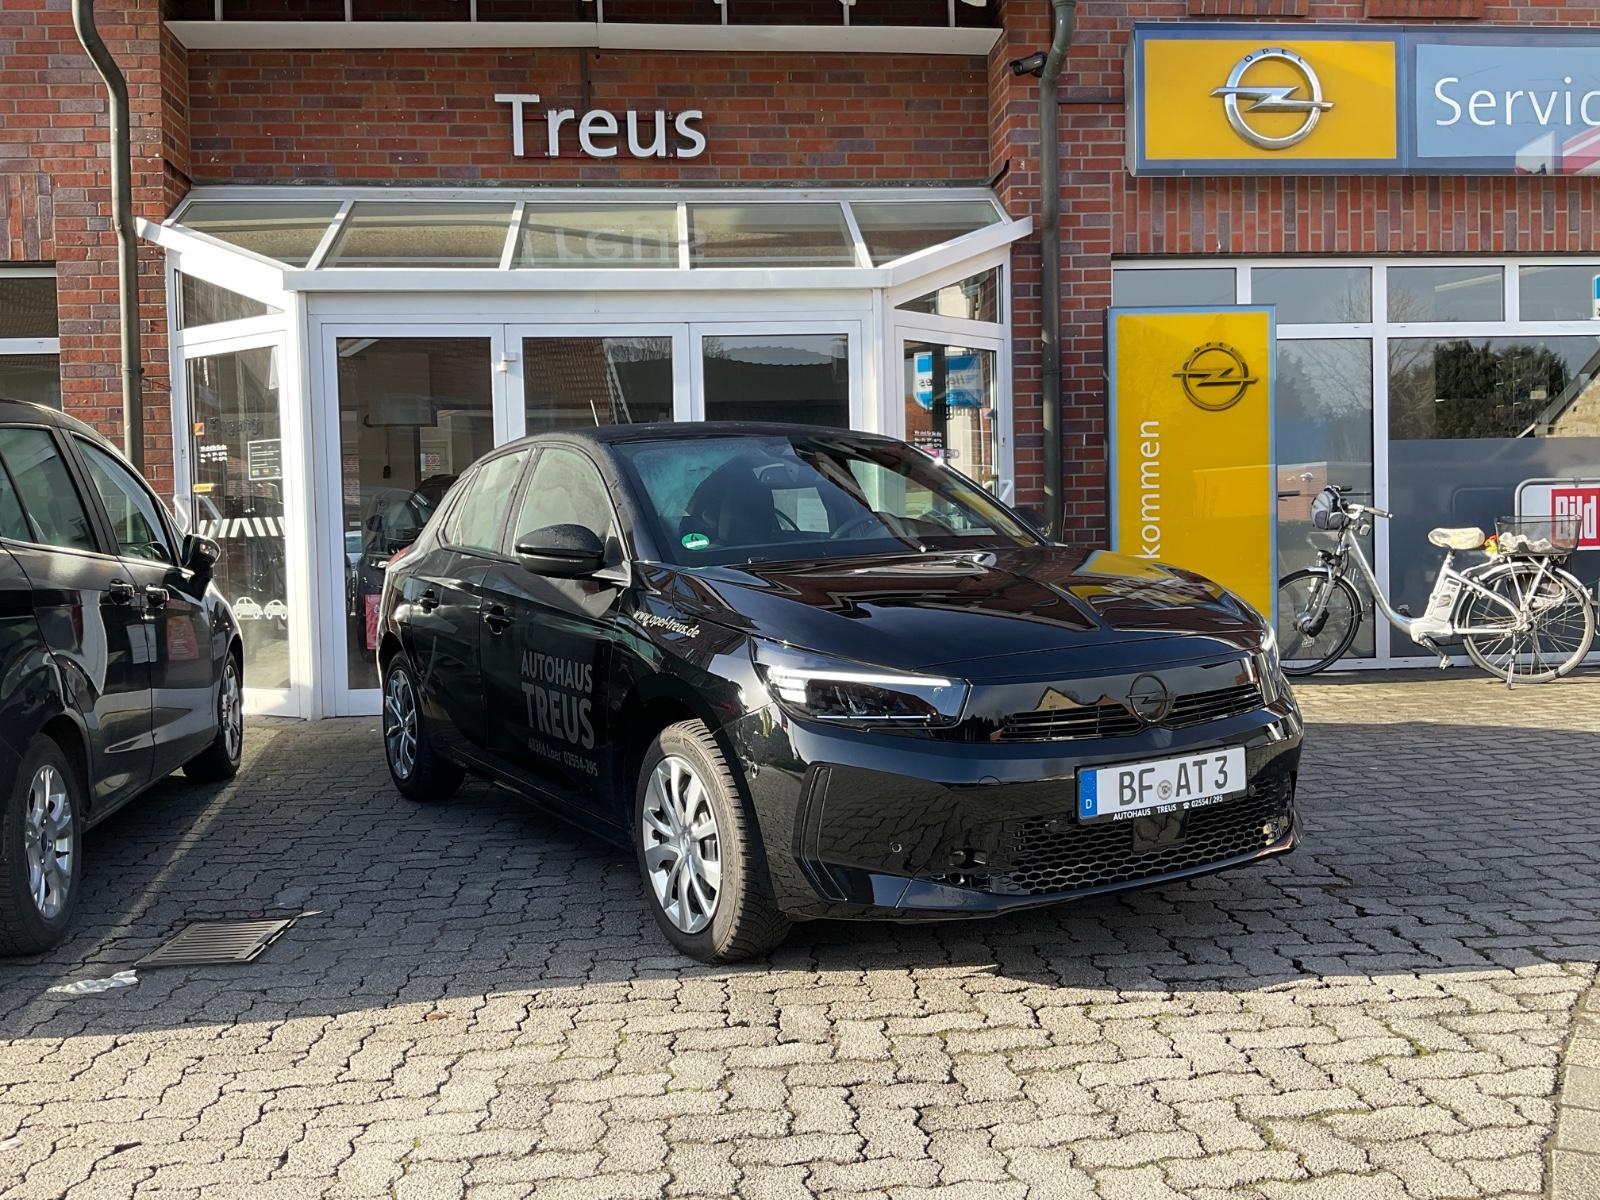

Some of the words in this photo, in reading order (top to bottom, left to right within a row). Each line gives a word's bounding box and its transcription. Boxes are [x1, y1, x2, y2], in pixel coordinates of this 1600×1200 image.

[1244, 48, 1304, 63] OPEL
[494, 93, 706, 159] Treus
[1136, 420, 1161, 560] kommen
[1555, 495, 1597, 540] Bild
[632, 610, 700, 639] www.opel-treus.de
[521, 650, 593, 694] AUTOHAUS
[521, 681, 595, 750] TREUS
[1118, 767, 1156, 806] BF
[1175, 759, 1208, 797] AT
[1214, 755, 1228, 790] 3
[1085, 798, 1093, 810] D
[1112, 808, 1151, 821] AUTOHAUS
[1156, 803, 1177, 814] TREUS
